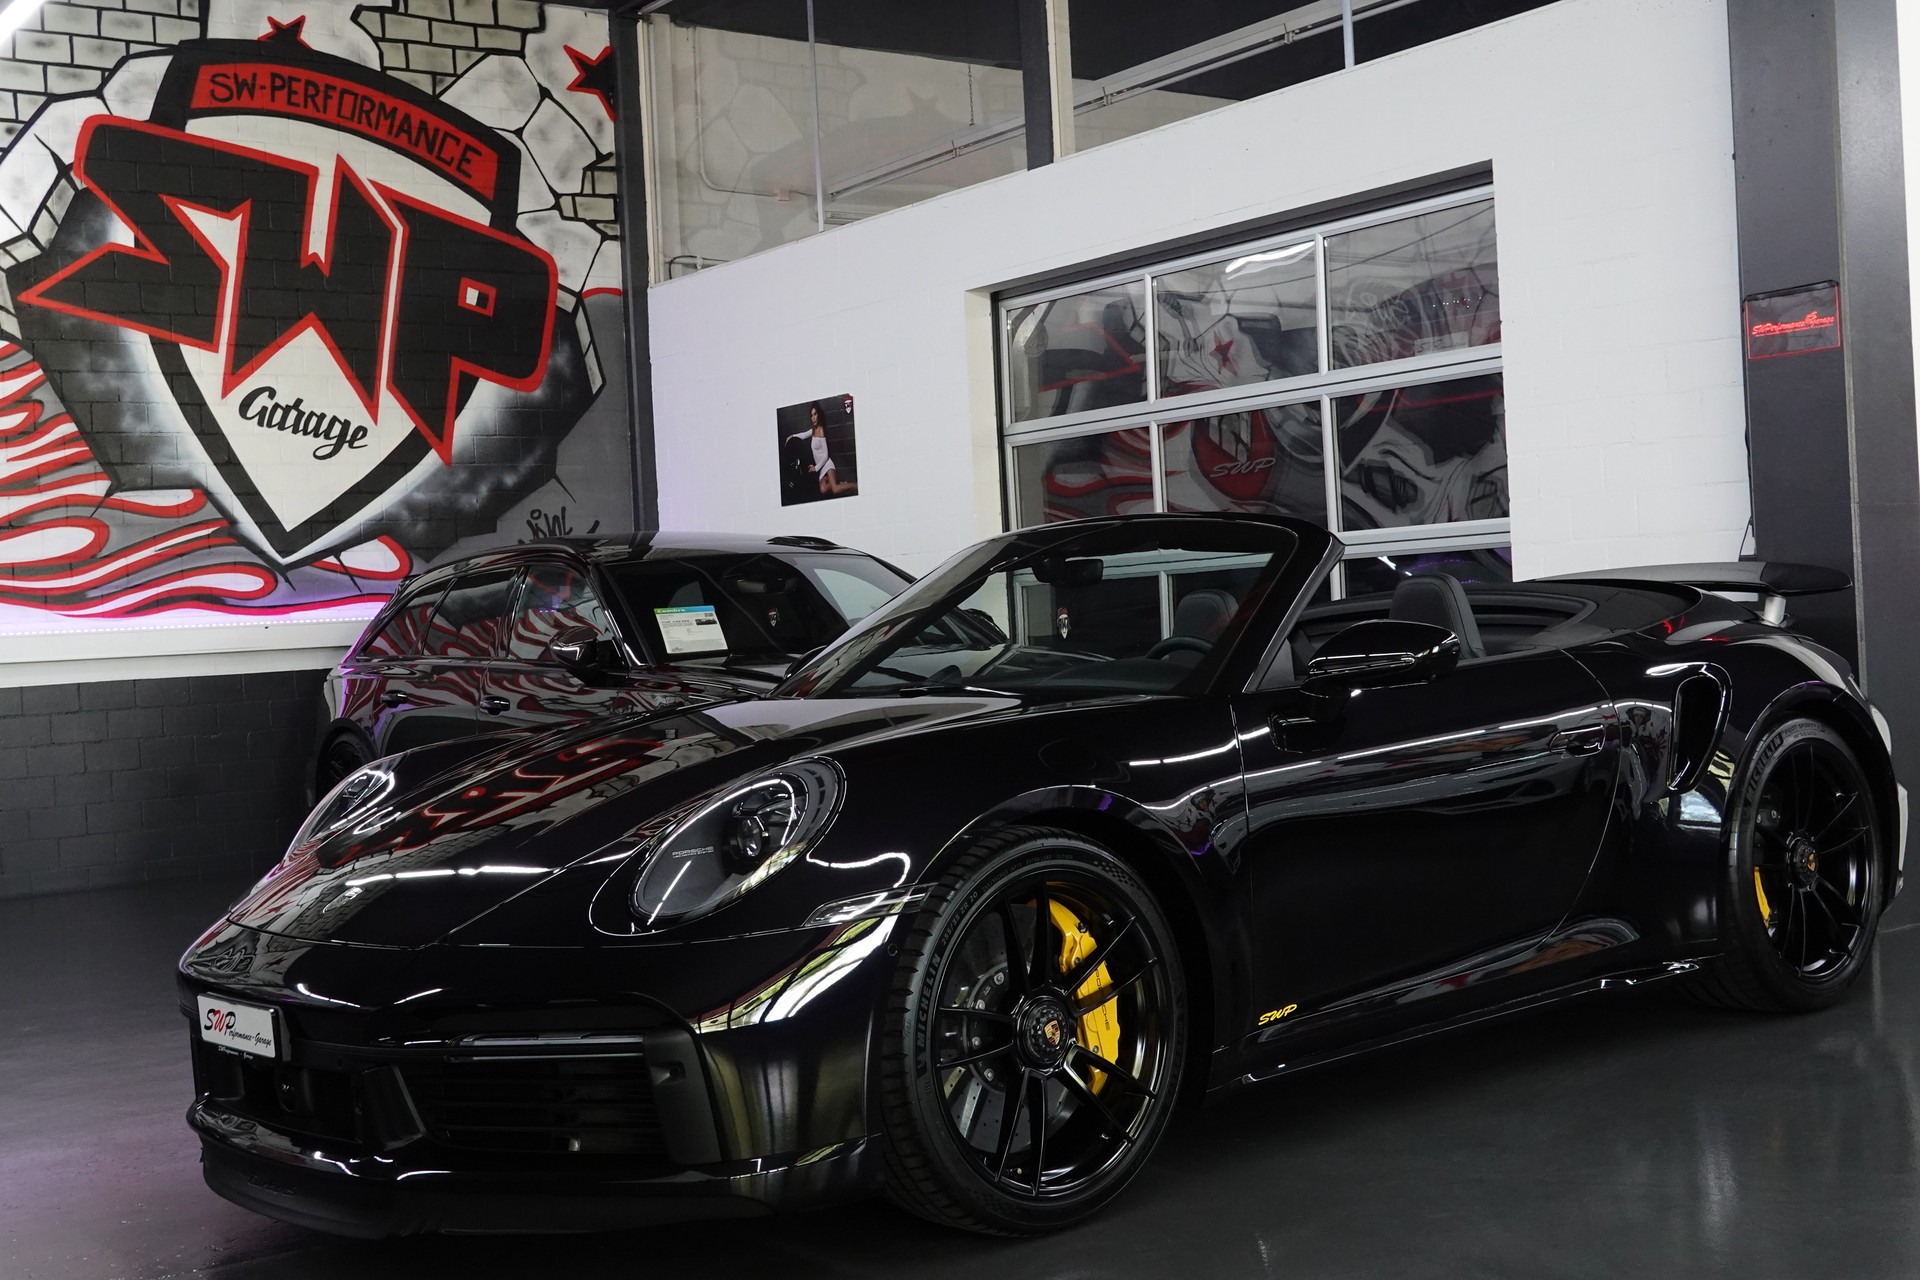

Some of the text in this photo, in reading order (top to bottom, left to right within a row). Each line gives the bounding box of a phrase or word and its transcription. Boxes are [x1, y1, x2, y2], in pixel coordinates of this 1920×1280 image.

[209, 71, 483, 181] SW-PERFORMANCE
[17, 115, 558, 467] SWP
[238, 385, 369, 459] Garage
[1209, 456, 1276, 478] SWP
[1746, 733, 1784, 803] MICHELIN
[917, 951, 942, 1049] MICHELIN
[969, 891, 979, 903] 20
[1258, 1003, 1298, 1026] SWP
